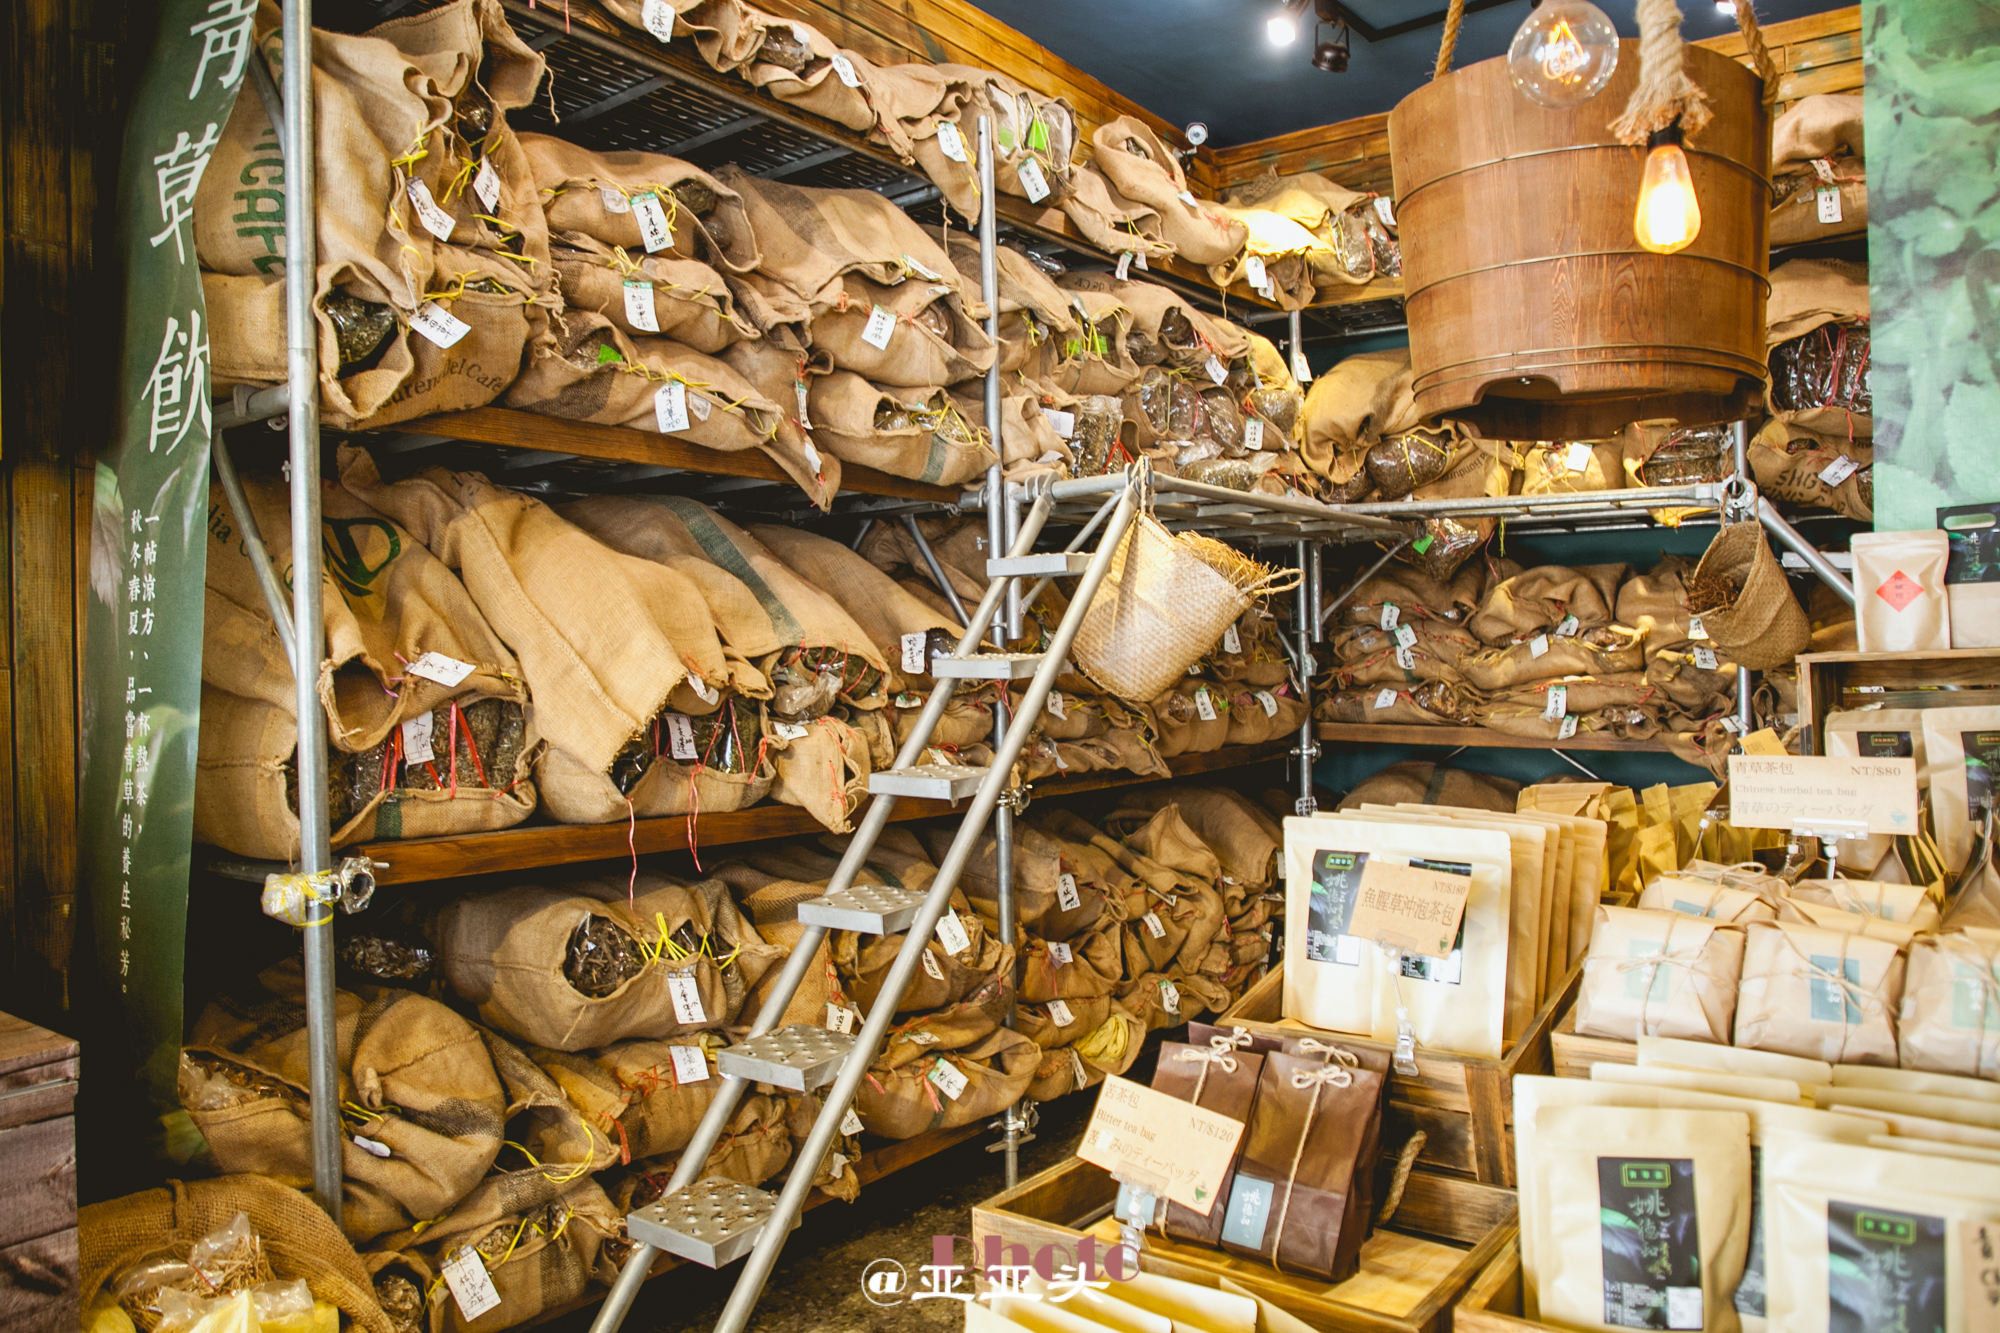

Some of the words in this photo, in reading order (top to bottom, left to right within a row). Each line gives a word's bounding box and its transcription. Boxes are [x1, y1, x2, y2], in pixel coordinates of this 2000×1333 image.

[1734, 761, 1794, 776] 青草茶包
[1851, 766, 1901, 777] NT/$80
[1735, 785, 1776, 794] Chinese
[1780, 785, 1813, 796] herbal
[1817, 787, 1834, 796] tea
[1837, 787, 1857, 798] bag
[1736, 801, 1875, 818] 青草のティーバッグ
[1104, 1082, 1140, 1109] 苦茶包
[1096, 1108, 1123, 1128] Bitter
[1124, 1121, 1138, 1134] tea
[1140, 1125, 1157, 1143] bag
[1188, 1117, 1235, 1144] NT/$120
